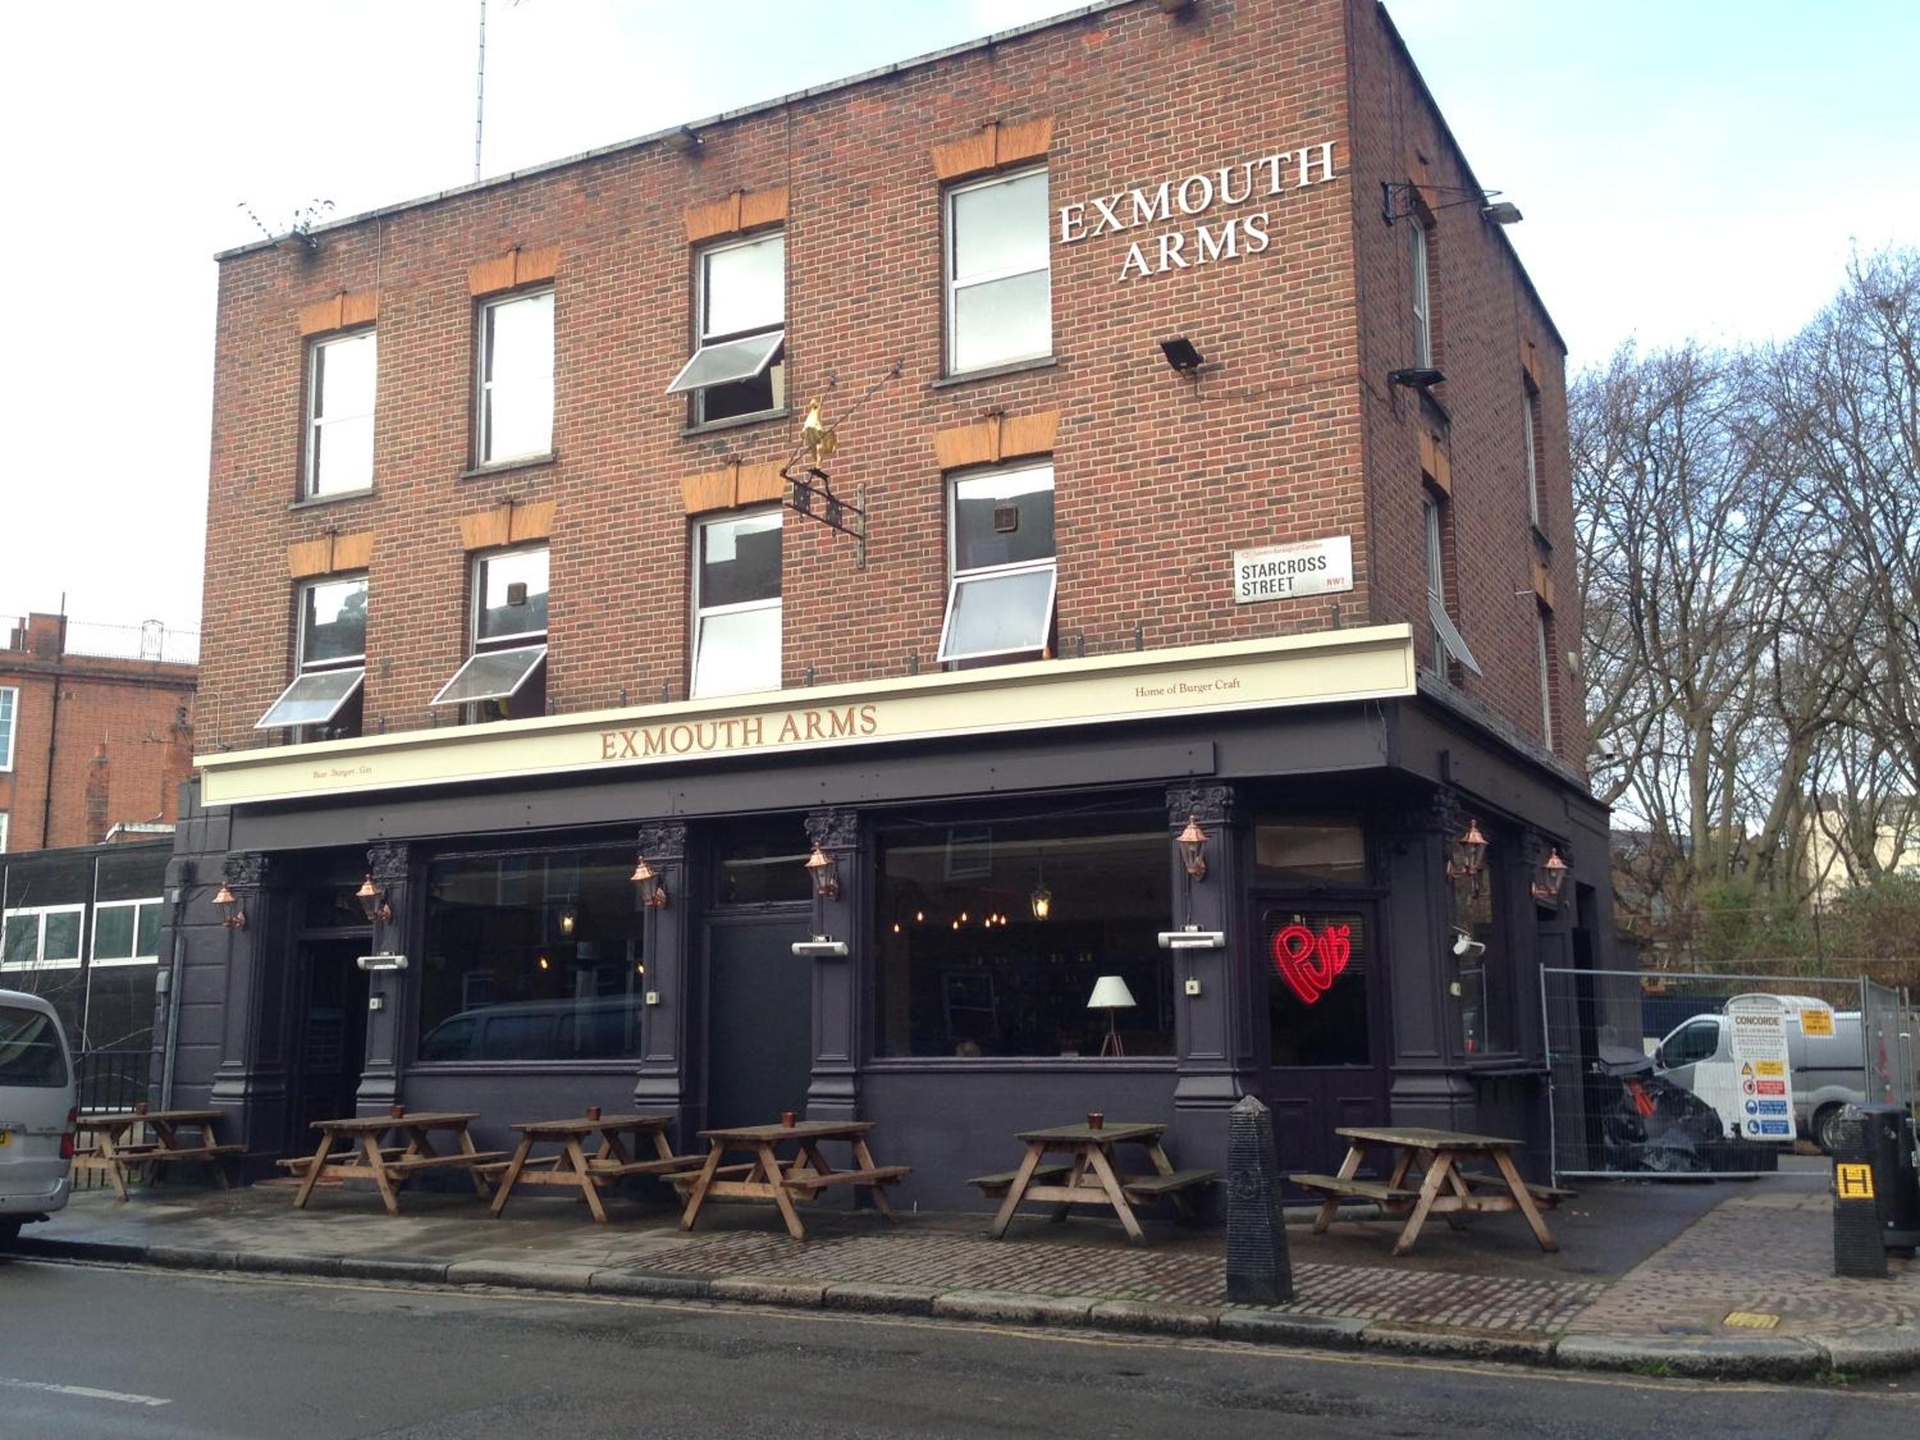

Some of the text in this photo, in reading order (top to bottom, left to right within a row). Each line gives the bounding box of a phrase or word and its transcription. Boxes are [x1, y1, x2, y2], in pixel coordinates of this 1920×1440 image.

[1058, 141, 1337, 244] EXMOUTH
[1118, 212, 1270, 282] ARMS
[1241, 555, 1327, 580] STARCROSS
[1242, 576, 1294, 596] STREET
[1326, 577, 1345, 587] NW1
[1135, 678, 1241, 698] Home of Burger Craft
[600, 705, 878, 760] EXMOUTH ARMS
[1735, 1015, 1780, 1026] CONCORDE
[1842, 1167, 1868, 1194] H
